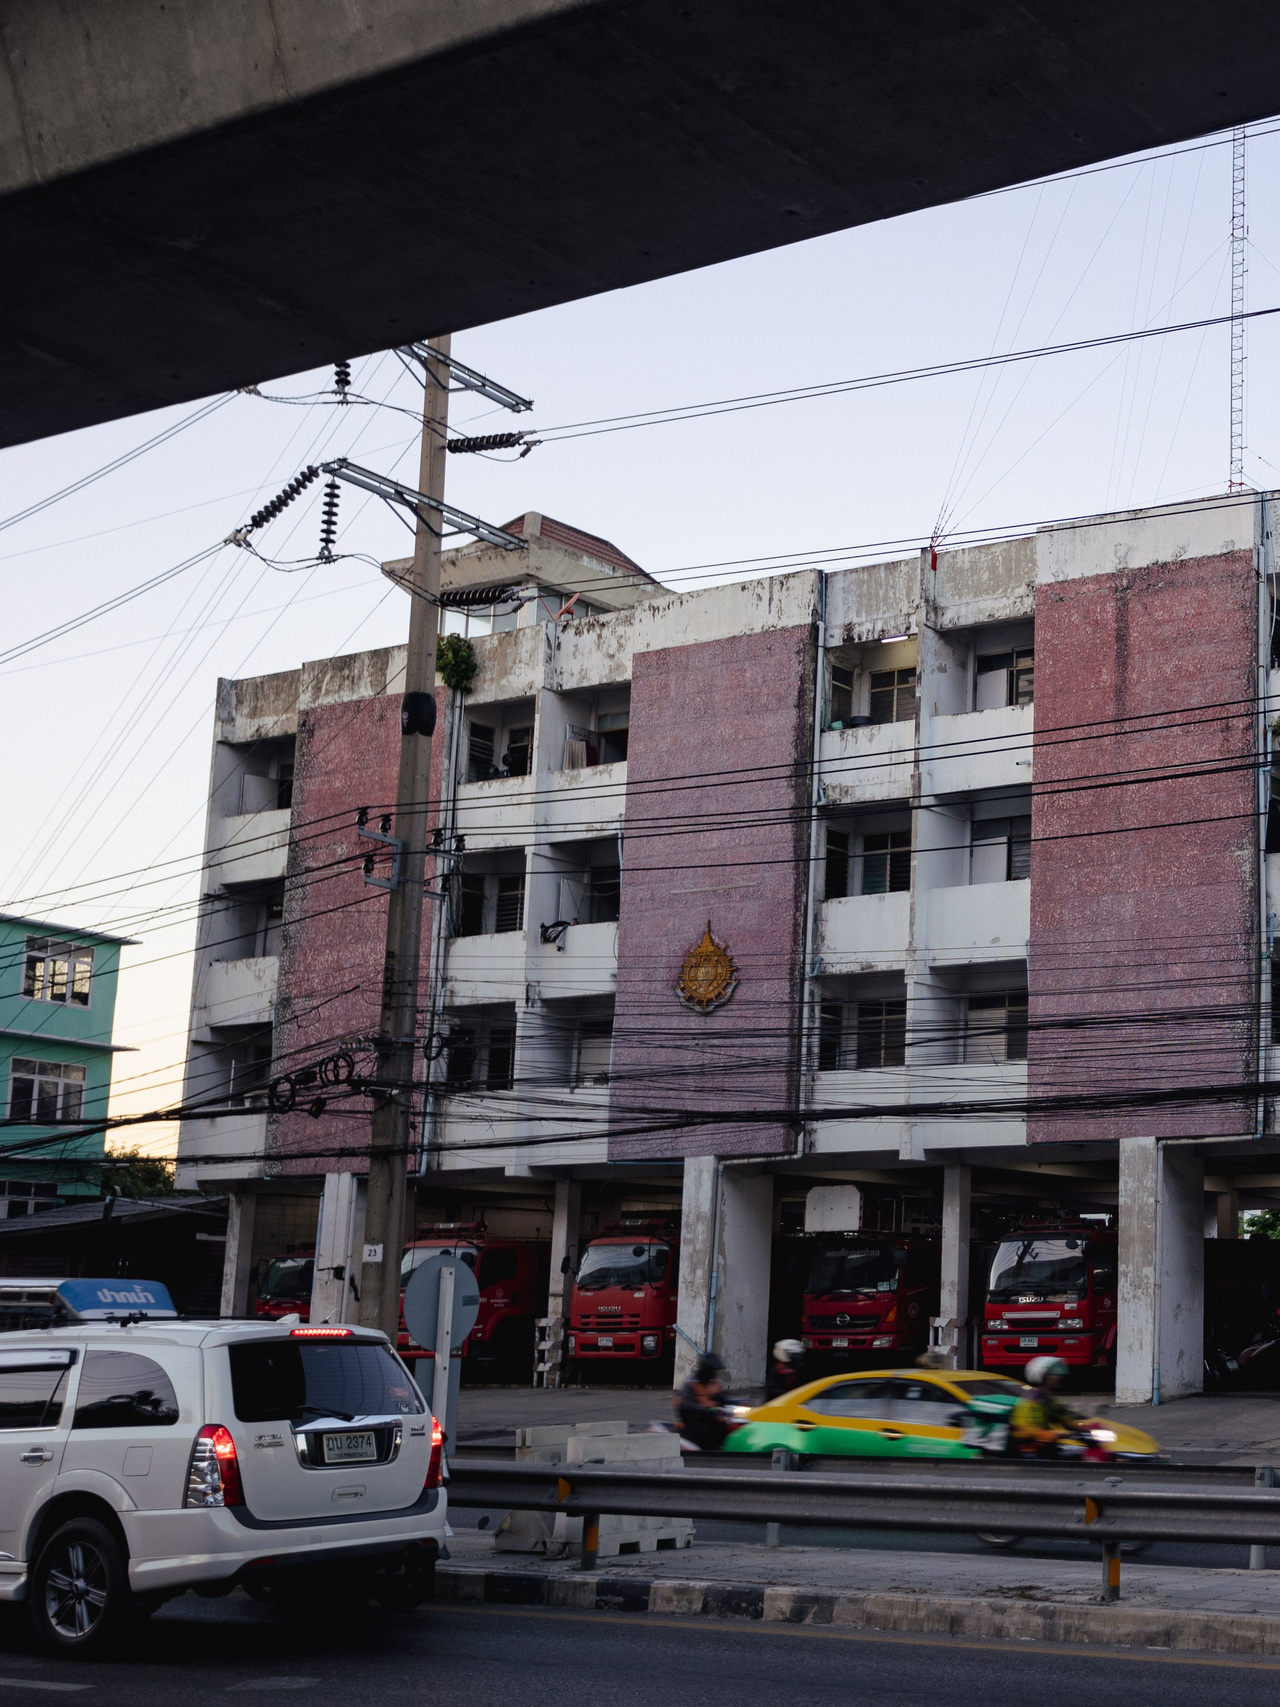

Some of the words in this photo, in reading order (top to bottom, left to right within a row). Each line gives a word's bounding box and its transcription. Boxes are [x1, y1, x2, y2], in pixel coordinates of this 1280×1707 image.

[367, 1248, 378, 1257] 23
[97, 1284, 156, 1304] ปากน้ำ
[597, 1305, 622, 1313] ISUZU
[346, 1435, 372, 1449] 2374
